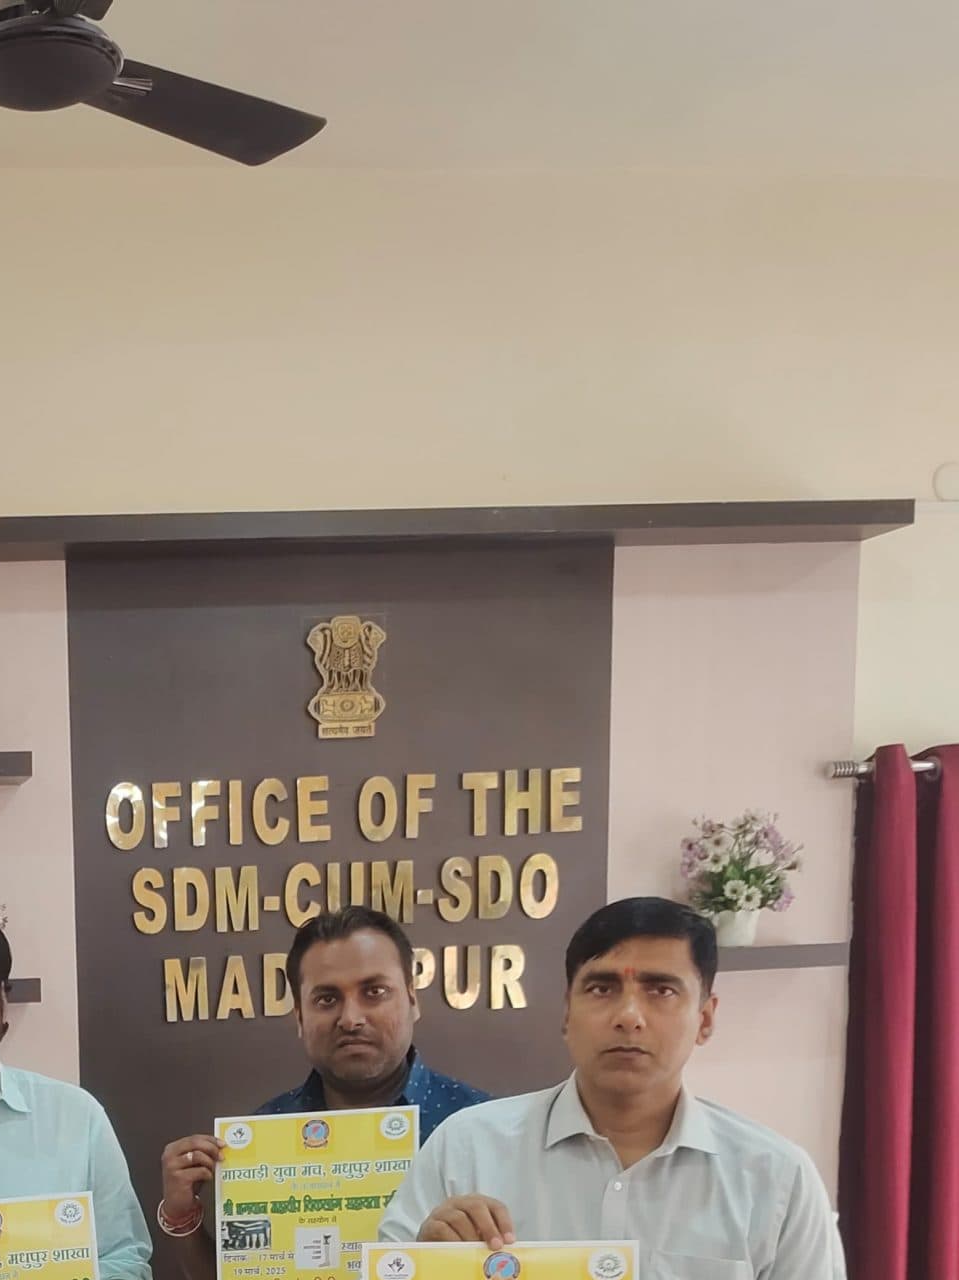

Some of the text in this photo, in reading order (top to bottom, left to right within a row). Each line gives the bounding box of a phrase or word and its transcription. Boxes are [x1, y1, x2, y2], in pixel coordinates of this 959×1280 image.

[105, 767, 583, 851] OFFICE OF THE
[131, 853, 559, 935] SDM-CUM-SDO
[163, 945, 528, 1023] MADPUR
